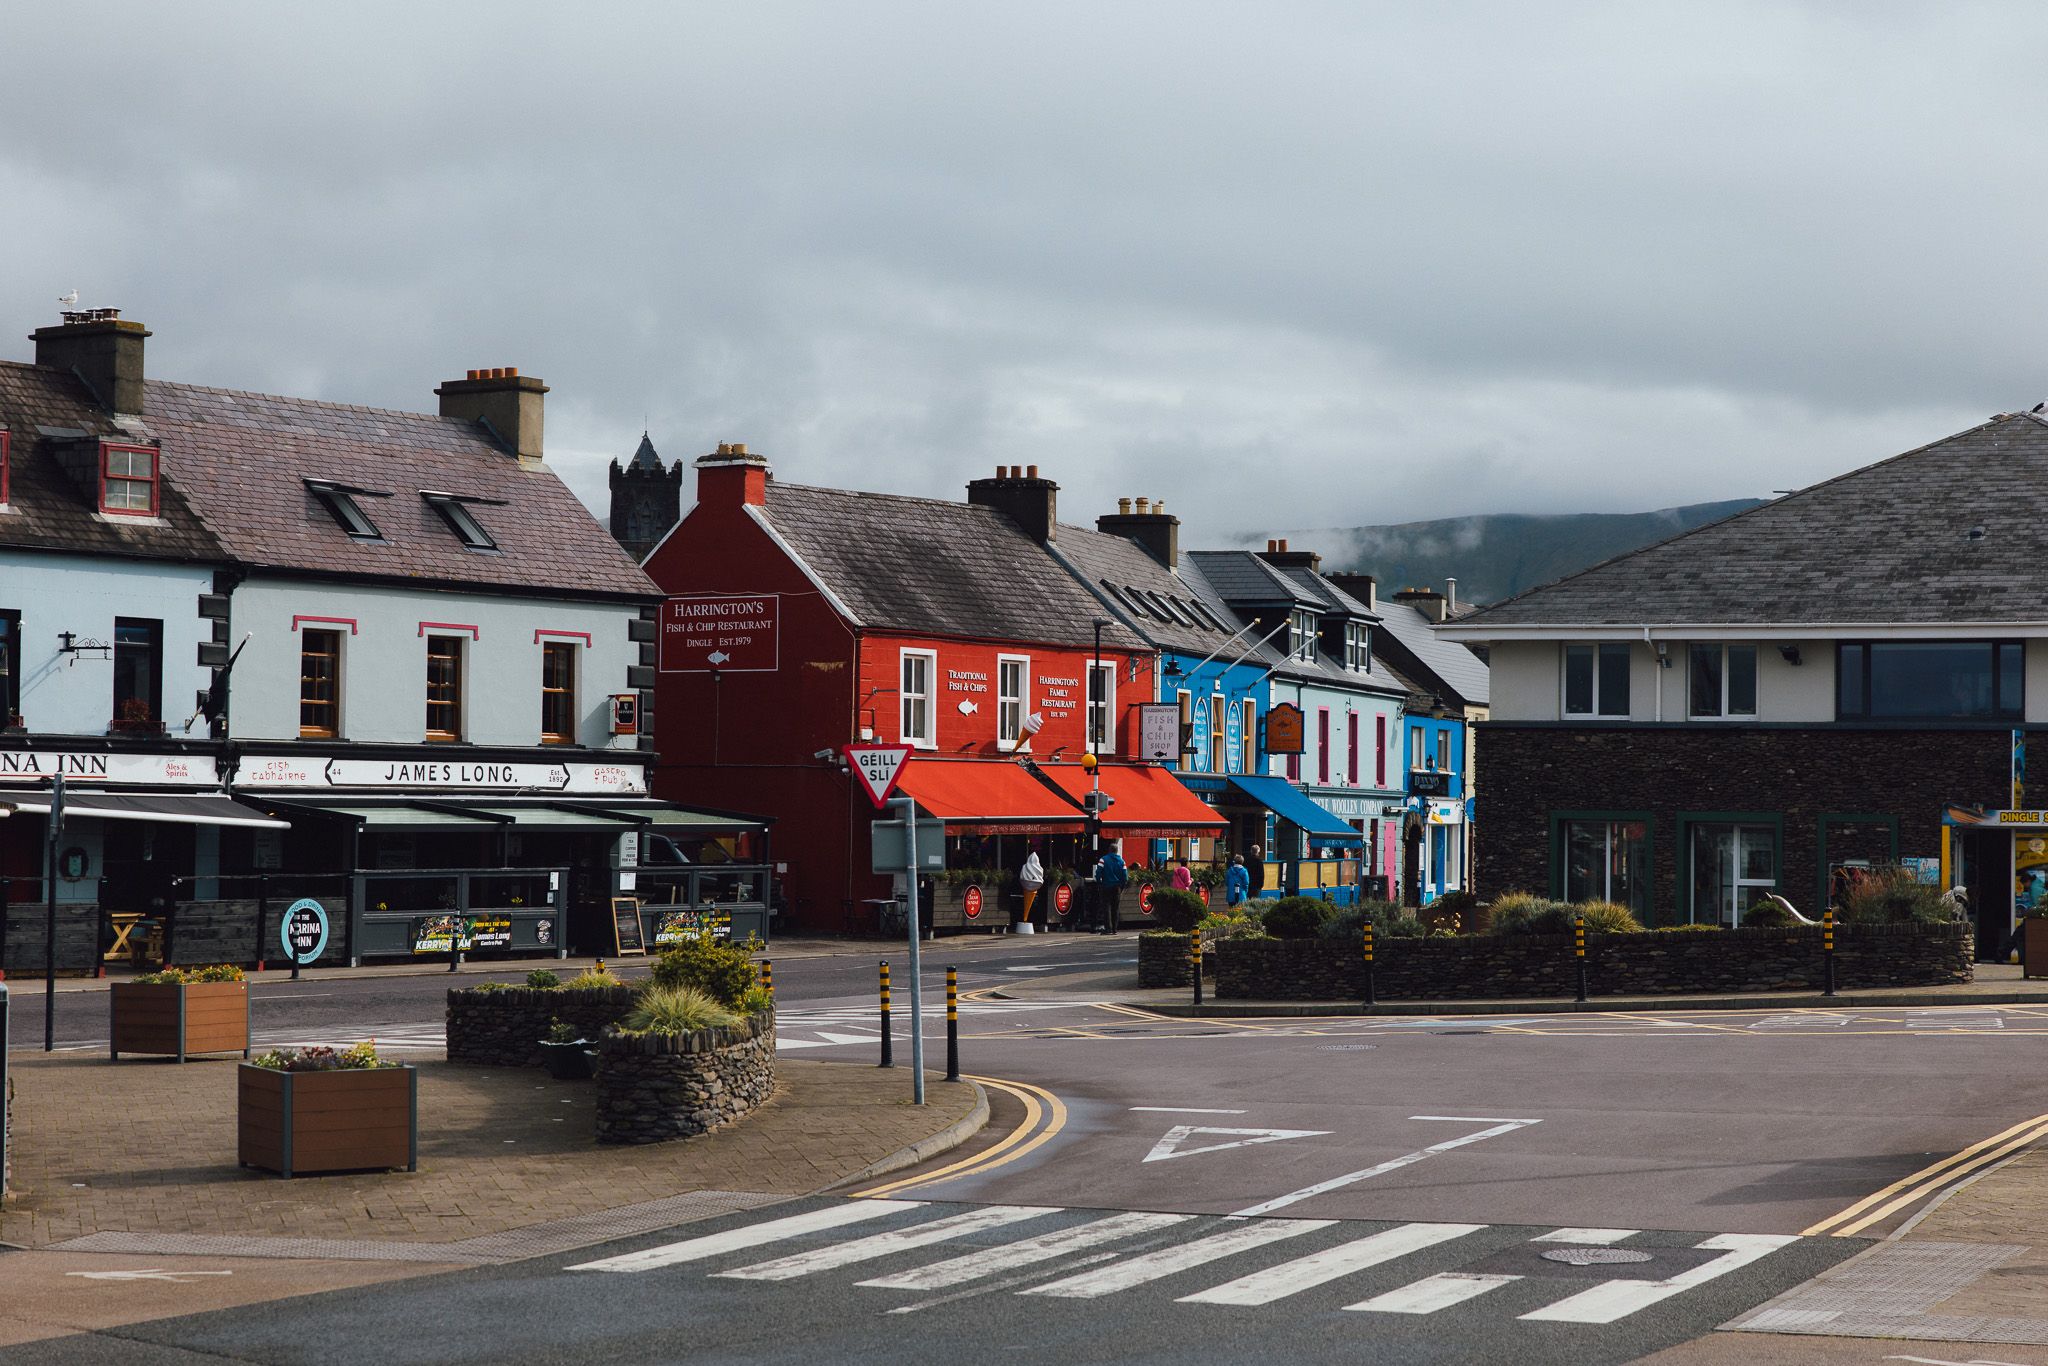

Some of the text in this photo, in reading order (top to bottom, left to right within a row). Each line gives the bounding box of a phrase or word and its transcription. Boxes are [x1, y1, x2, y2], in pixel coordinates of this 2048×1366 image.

[675, 601, 764, 617] HARRINGTON'S
[666, 620, 772, 633] FISH & CHIP RESTAURANT
[686, 639, 713, 647] DINGLE
[948, 669, 987, 681] TRADITIONAL
[1040, 675, 1078, 687] HARRINGTON'S
[949, 682, 987, 692] FISH & CHIPS
[1049, 687, 1068, 697] FAMILY
[1041, 698, 1076, 709] RESTAURANT
[1147, 715, 1174, 725] FISH
[1147, 732, 1174, 741] CHIP
[1150, 742, 1171, 750] SHOP
[57, 754, 108, 774] INN
[860, 752, 897, 767] GÉILL
[165, 763, 181, 771] Ales
[332, 768, 341, 776] 44
[165, 769, 188, 778] Spirits
[385, 764, 451, 782] JAMES
[869, 767, 889, 781] SLÍ
[1332, 798, 1358, 815] WOOLLEN
[1360, 799, 1384, 815] COMPANY
[2000, 811, 2039, 823] DINGLE
[288, 903, 302, 917] FOOD
[308, 901, 323, 915] DRINK
[298, 936, 312, 947] INN
[475, 932, 510, 941] James Long
[415, 938, 472, 951] KERRY TAM
